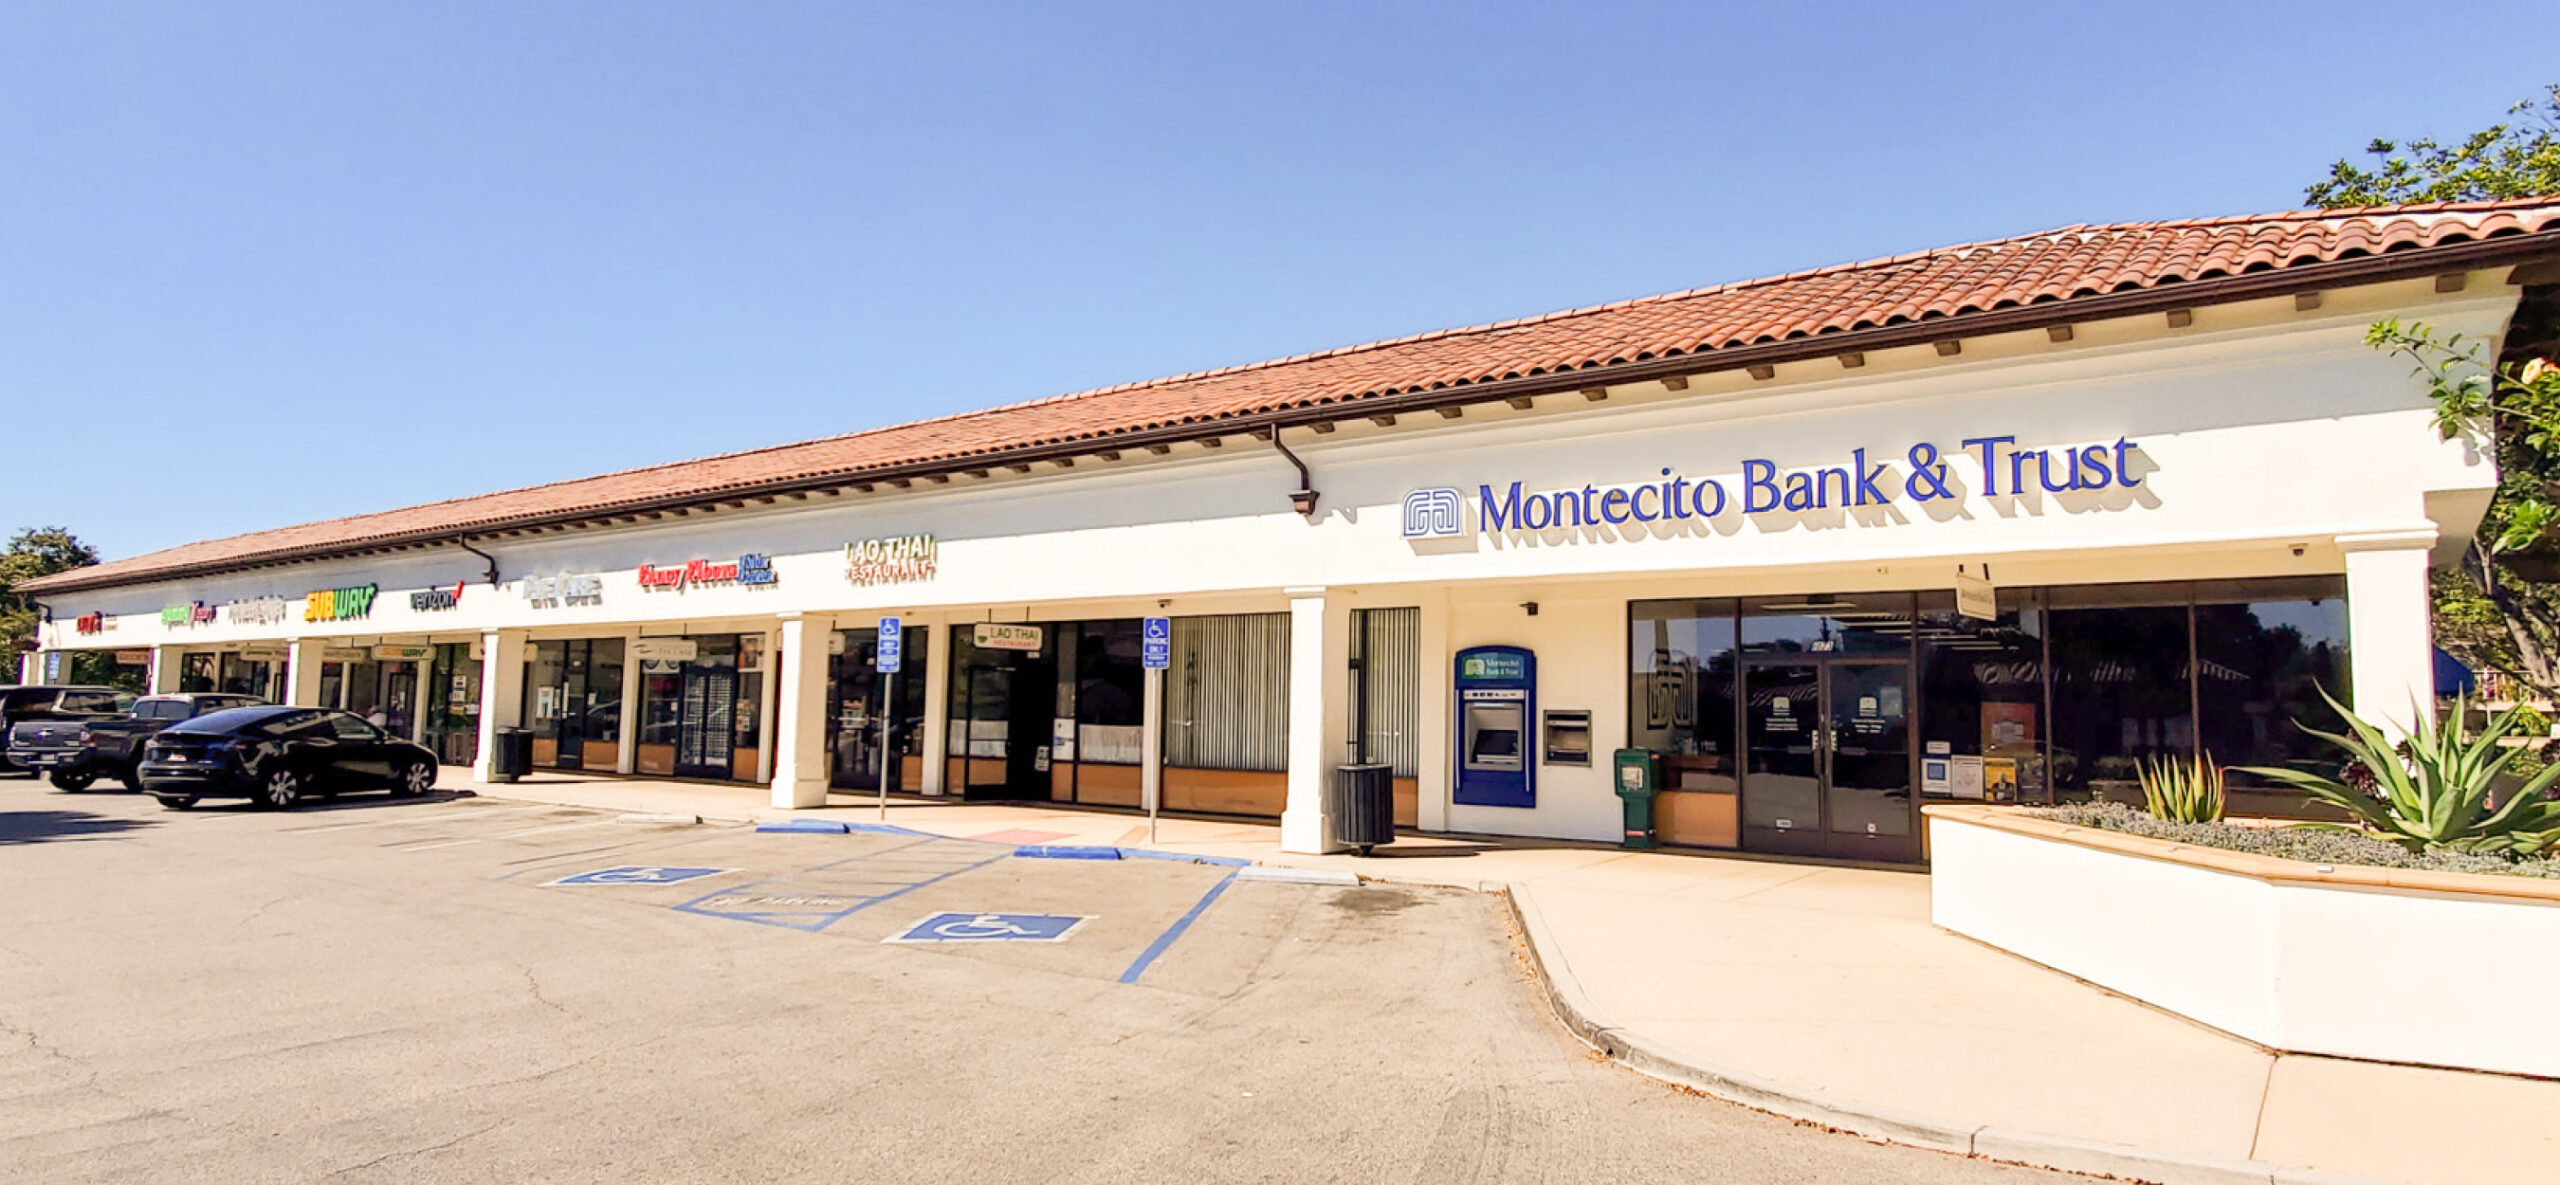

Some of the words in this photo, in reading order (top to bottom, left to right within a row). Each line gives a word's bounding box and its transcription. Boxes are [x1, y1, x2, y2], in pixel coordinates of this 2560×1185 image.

[1479, 467, 1726, 532] Montecito
[1741, 447, 1890, 513] Bank
[1905, 442, 1955, 501] &
[1961, 435, 2142, 496] Trust
[885, 533, 933, 561] THAI
[304, 583, 378, 621] SUBWAY
[410, 586, 457, 610] verizon
[990, 626, 1012, 639] LAO
[1015, 628, 1039, 640] THAI
